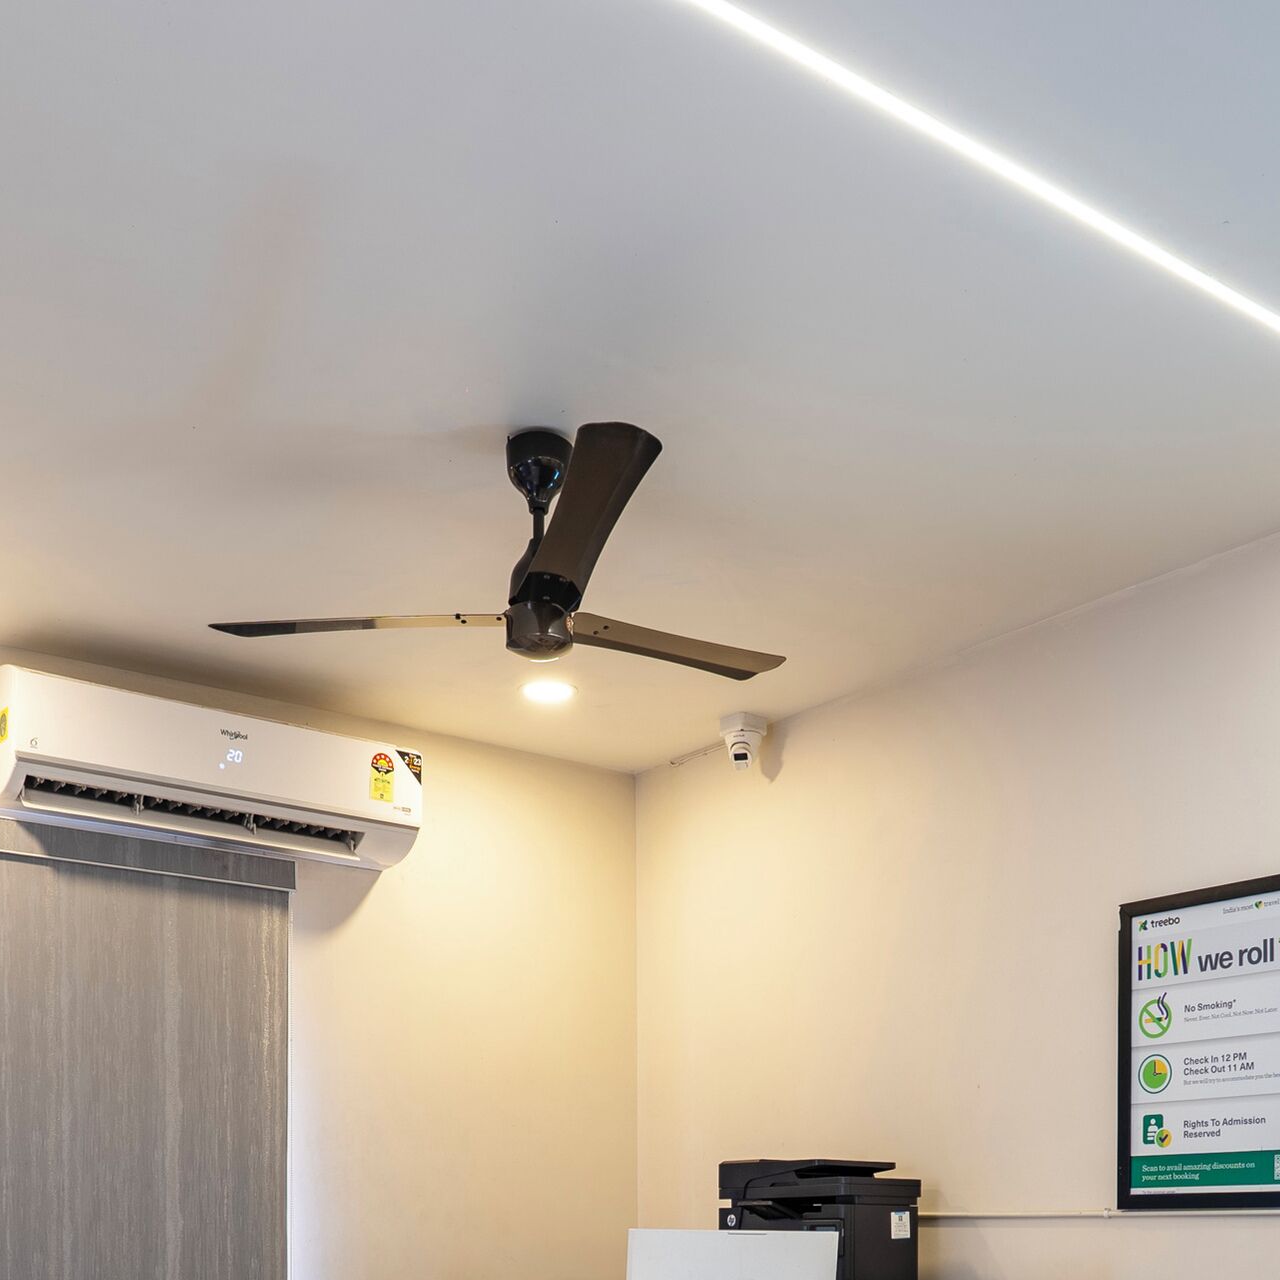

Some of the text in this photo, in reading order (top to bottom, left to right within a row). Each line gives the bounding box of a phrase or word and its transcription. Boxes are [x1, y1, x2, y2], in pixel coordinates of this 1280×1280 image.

[226, 749, 243, 763] 20
[1150, 916, 1181, 929] treebo
[1138, 937, 1275, 981] HOW we roll
[1184, 1004, 1196, 1013] No
[1183, 1051, 1247, 1066] Check In 12 PM
[1183, 1061, 1255, 1076] Check Out 11 AM
[1183, 1116, 1266, 1129] Rights To Admission
[1183, 1129, 1221, 1138] Reserved
[1142, 1164, 1158, 1172] Scan
[1166, 1163, 1182, 1171] avail
[1183, 1162, 1211, 1171] amazing
[1211, 1161, 1245, 1170] discounts
[1142, 1172, 1200, 1182] your next booking
